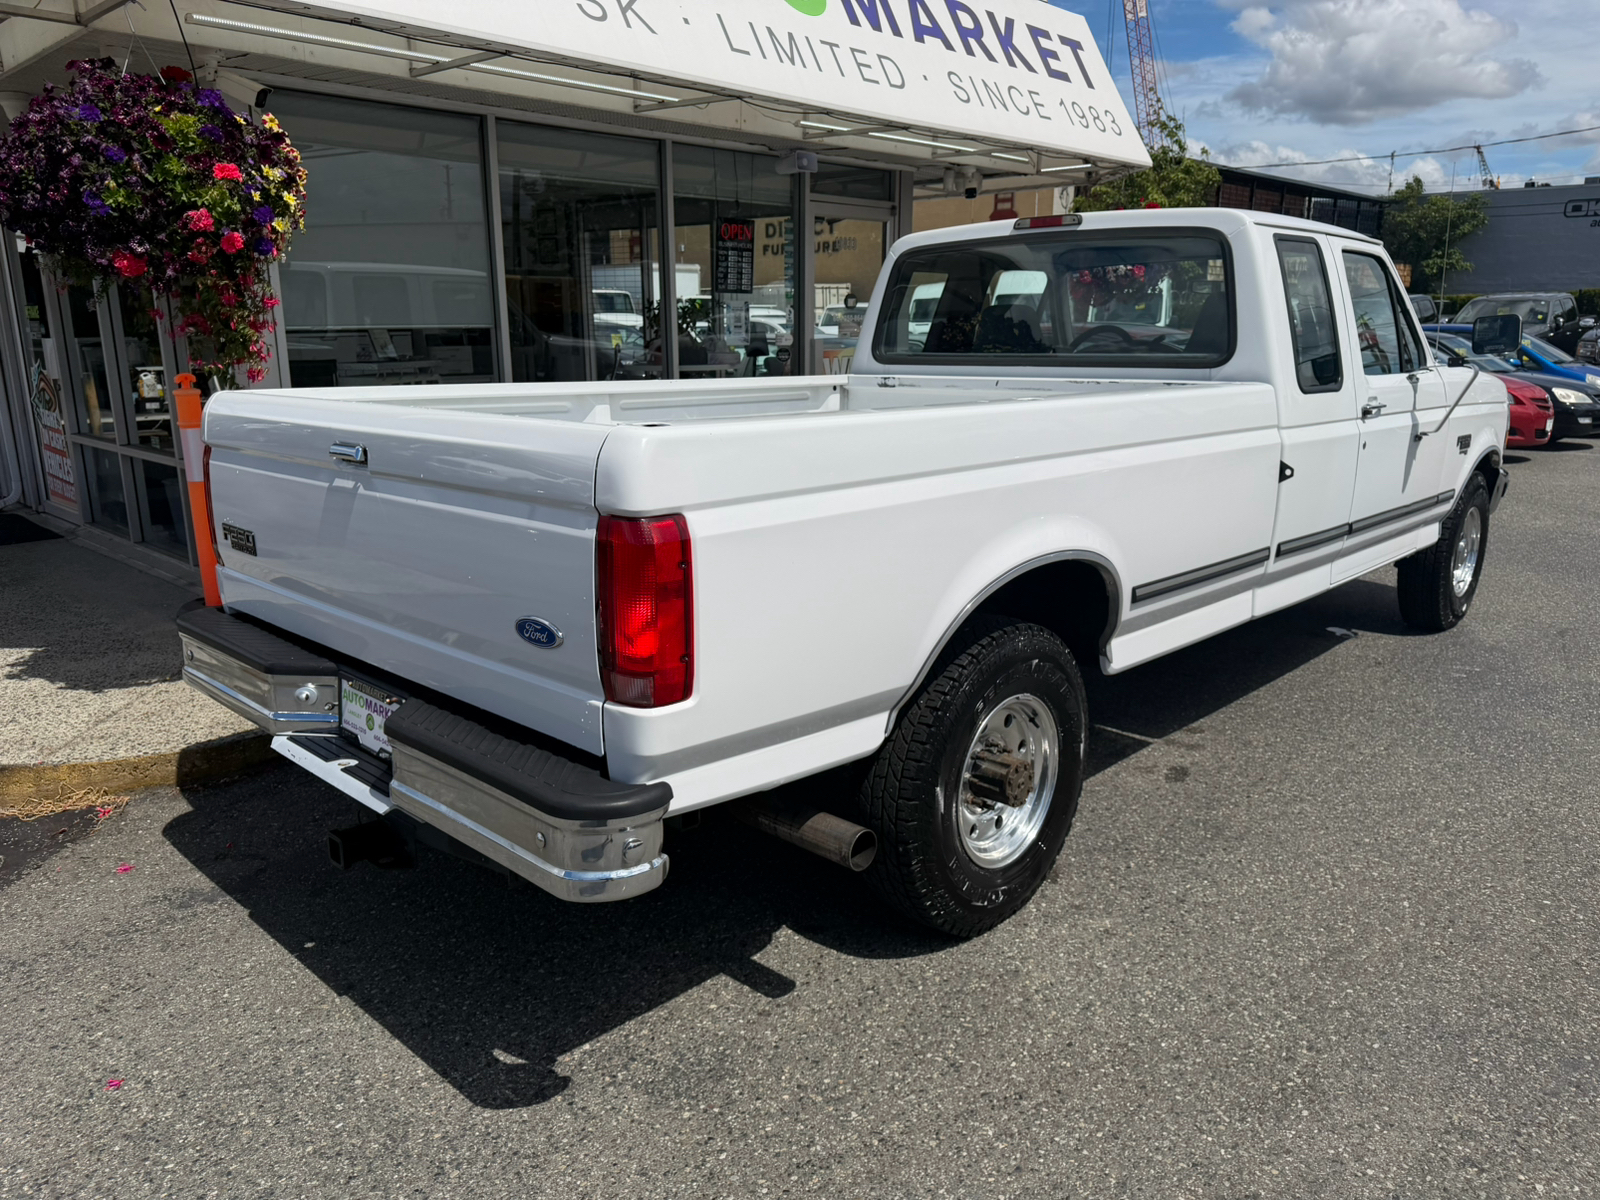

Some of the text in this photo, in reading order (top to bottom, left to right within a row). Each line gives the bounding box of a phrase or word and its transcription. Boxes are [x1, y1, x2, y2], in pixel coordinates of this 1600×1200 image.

[840, 0, 1096, 91] MARKET
[716, 13, 907, 90] LIMITED
[946, 70, 1052, 122] SINCE
[1058, 98, 1124, 137] 1983
[721, 222, 753, 241] OPEN
[523, 621, 549, 643] Ford
[342, 688, 394, 720] AUTOMARK
